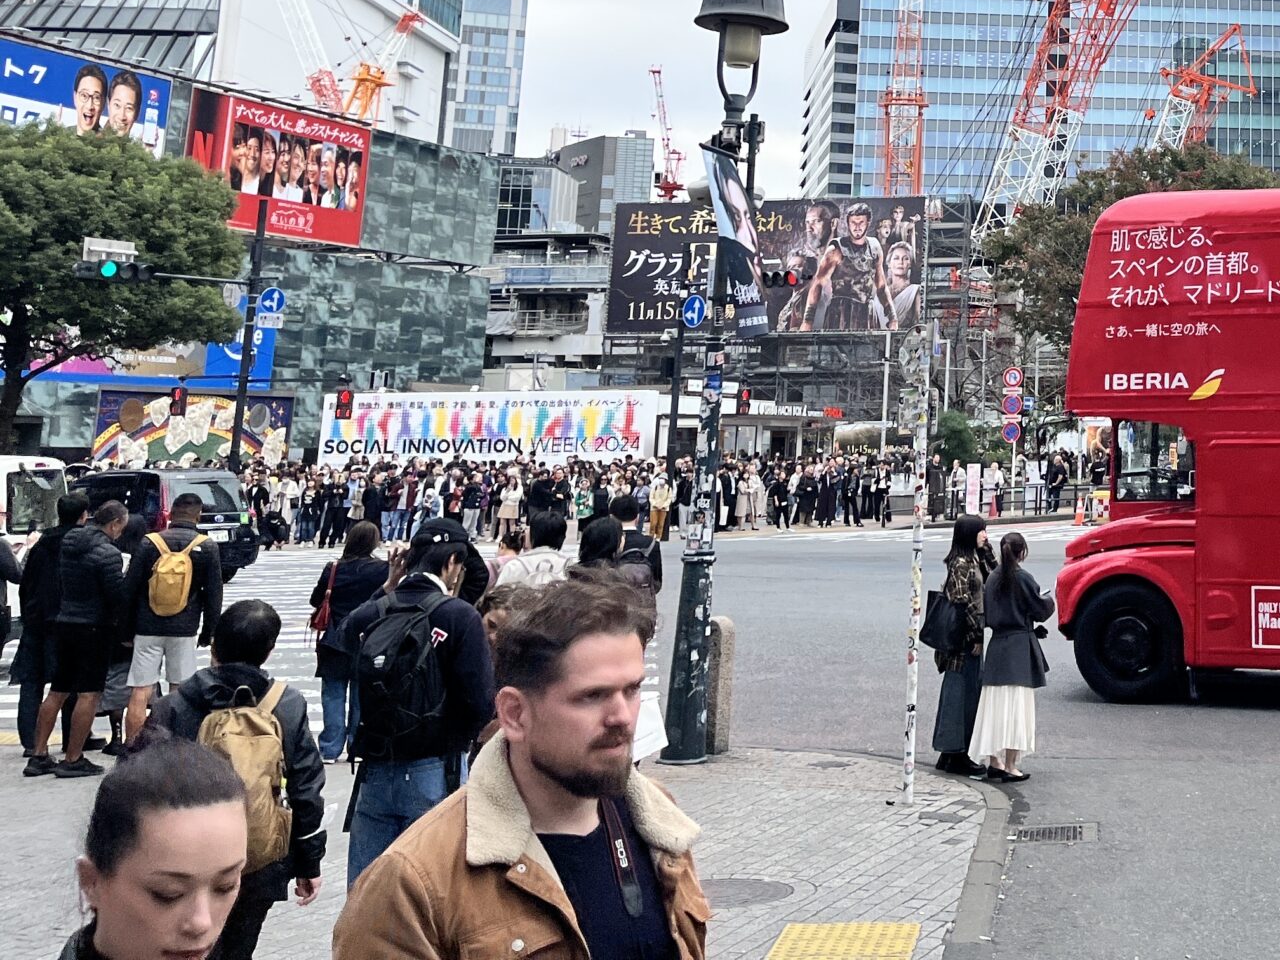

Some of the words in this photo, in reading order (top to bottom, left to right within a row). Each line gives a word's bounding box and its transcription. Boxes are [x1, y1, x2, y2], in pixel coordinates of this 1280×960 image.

[1110, 226, 1214, 252] 肌で感じる、
[1108, 252, 1259, 279] スペインの首都。
[1105, 322, 1221, 338] さあ、一緒に空の旅へ
[1104, 372, 1189, 390] IBERIA
[323, 439, 394, 454] SOCIAL
[402, 438, 522, 453] INNOVATION
[531, 437, 587, 453] WEEK
[594, 436, 641, 452] 2024
[1258, 602, 1279, 613] ONLY
[614, 838, 629, 868] EOS
